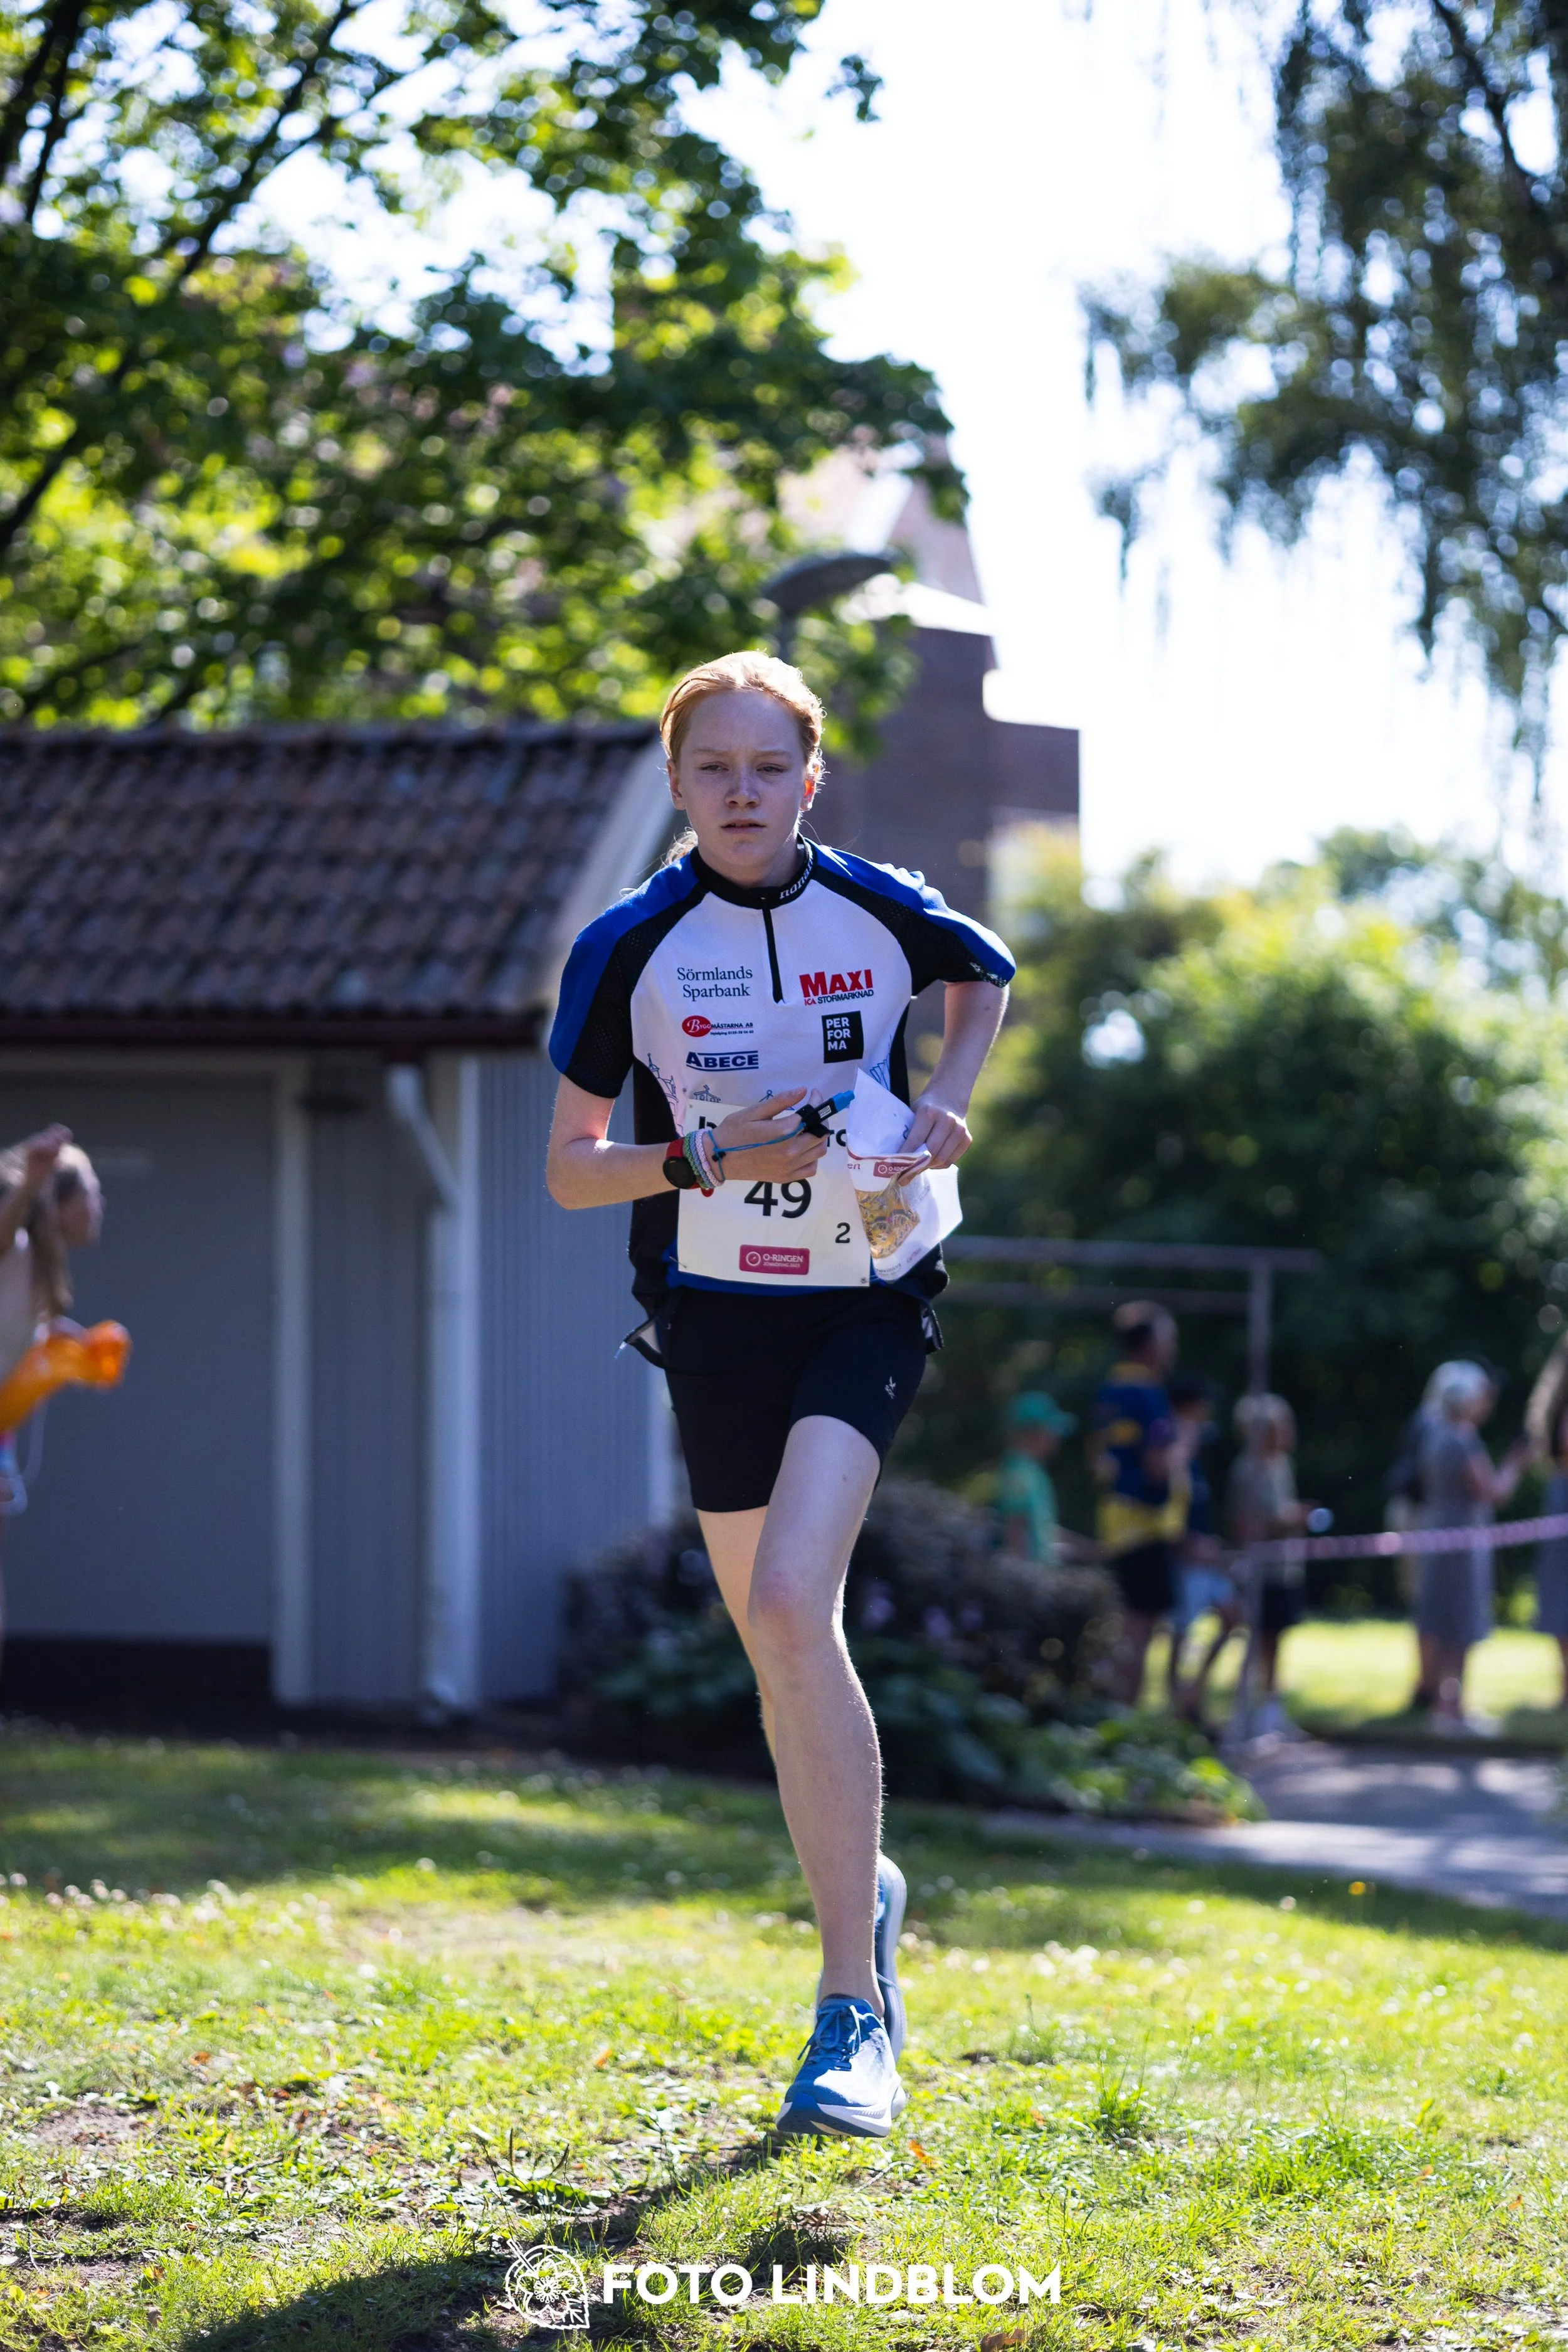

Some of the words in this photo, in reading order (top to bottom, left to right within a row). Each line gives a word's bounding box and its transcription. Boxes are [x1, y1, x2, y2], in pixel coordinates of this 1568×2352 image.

[677, 966, 753, 980] Sörmlands
[799, 969, 873, 998] MAXI
[683, 983, 751, 1002] Sparbank
[817, 989, 874, 1004] STORMARKNAD
[826, 1017, 850, 1029] PER
[827, 1029, 851, 1040] FOR
[828, 1040, 847, 1051] MA
[686, 1051, 759, 1067] ABECE
[744, 1179, 812, 1219] 49
[835, 1222, 850, 1243] 2
[763, 1254, 803, 1263] O-RINGEN
